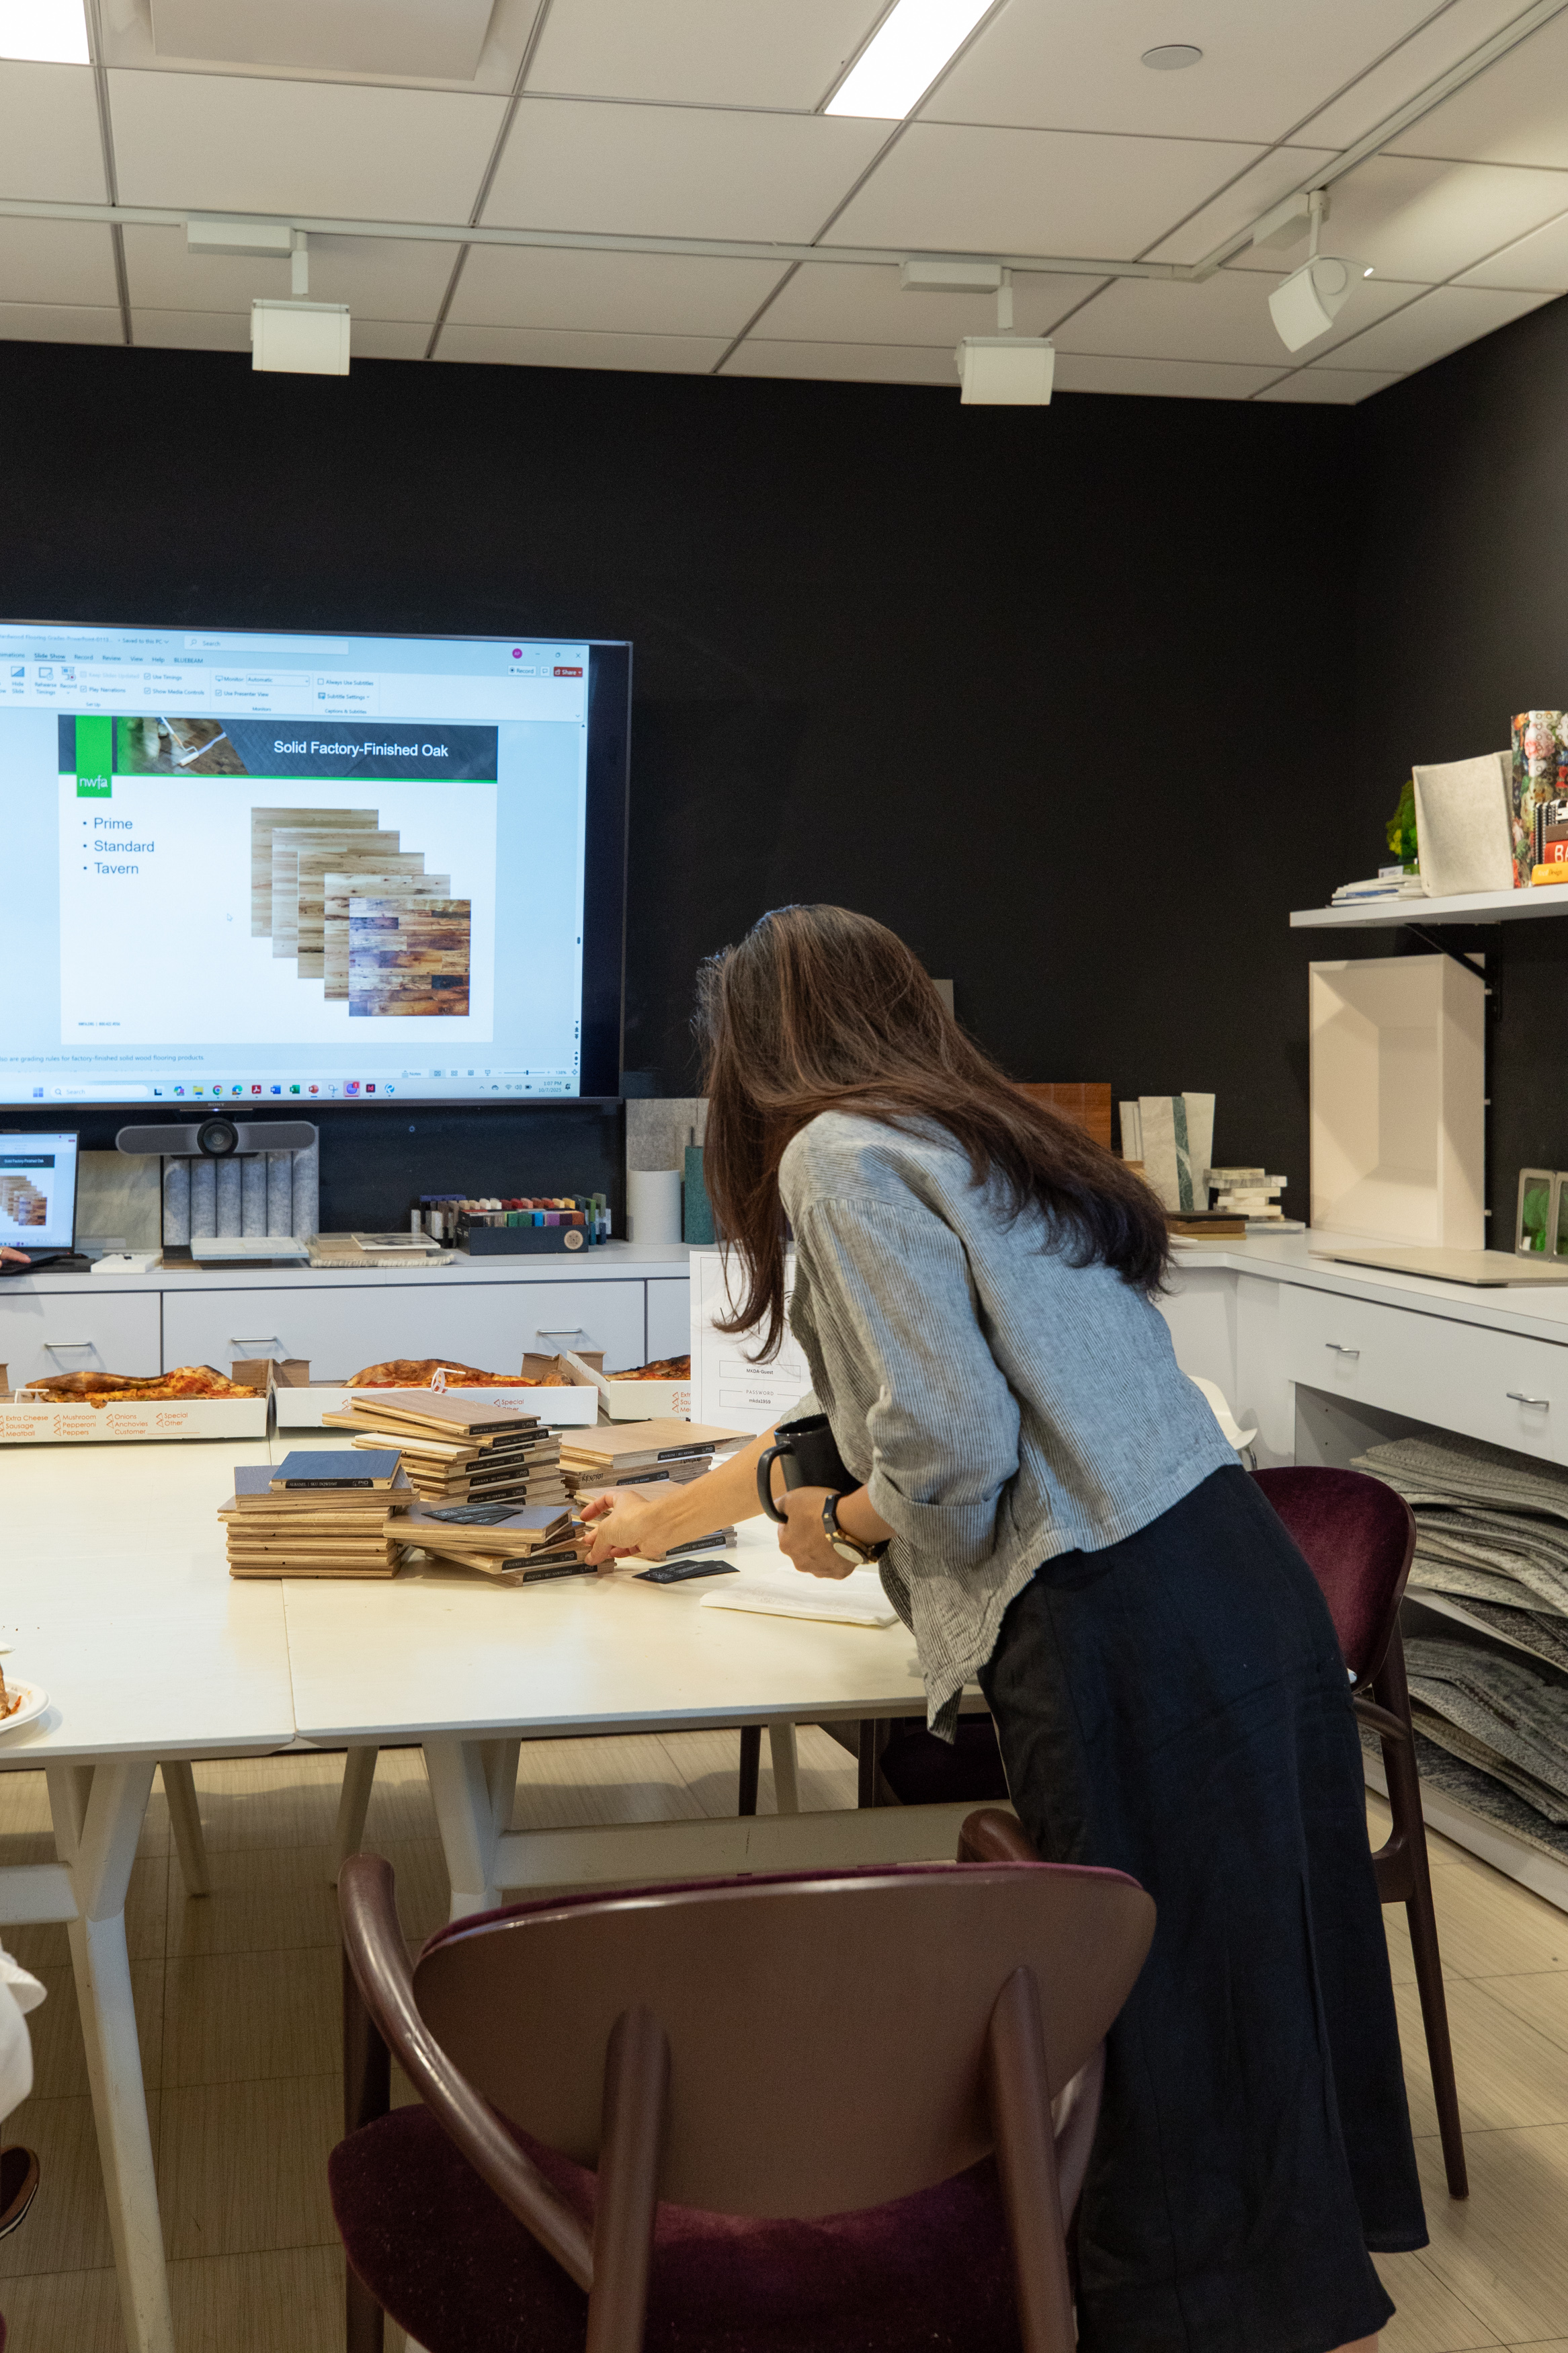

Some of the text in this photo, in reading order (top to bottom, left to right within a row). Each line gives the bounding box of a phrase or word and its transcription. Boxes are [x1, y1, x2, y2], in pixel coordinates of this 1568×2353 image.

[274, 740, 449, 758] Solid Factory-Finished Oak
[79, 773, 108, 790] nwfa
[93, 817, 133, 830] Prime
[93, 840, 155, 853] Standard
[94, 862, 139, 875] Tavern
[71, 1055, 118, 1063] factory-finished
[153, 1054, 177, 1062] flooring
[501, 1398, 524, 1406] Special
[164, 1412, 188, 1420] Special
